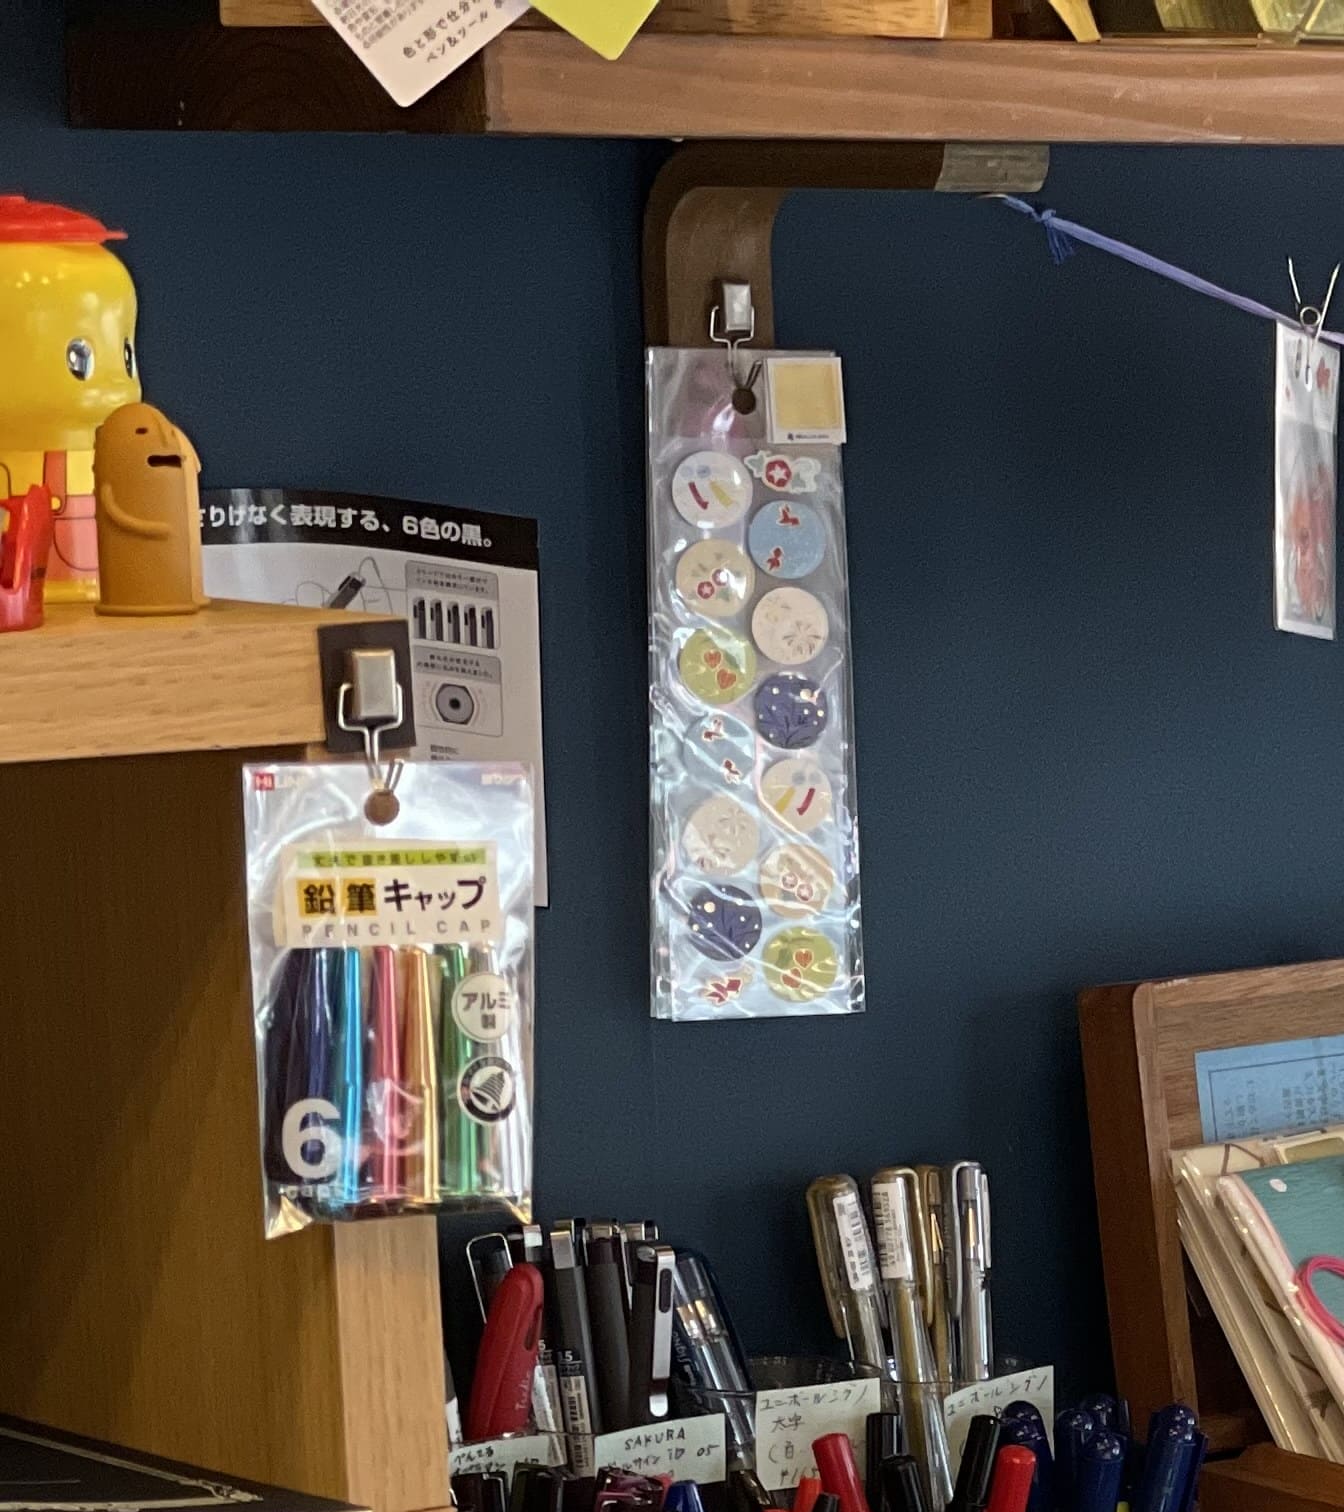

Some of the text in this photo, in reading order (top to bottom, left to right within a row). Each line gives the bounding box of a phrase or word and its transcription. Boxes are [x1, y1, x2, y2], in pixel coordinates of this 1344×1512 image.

[302, 878, 488, 915] 鉛筆キャップ
[301, 919, 493, 938] PENCIL CAP
[463, 990, 511, 1013] アルミ
[282, 1097, 343, 1180] 6
[625, 1425, 687, 1451] SAKURA
